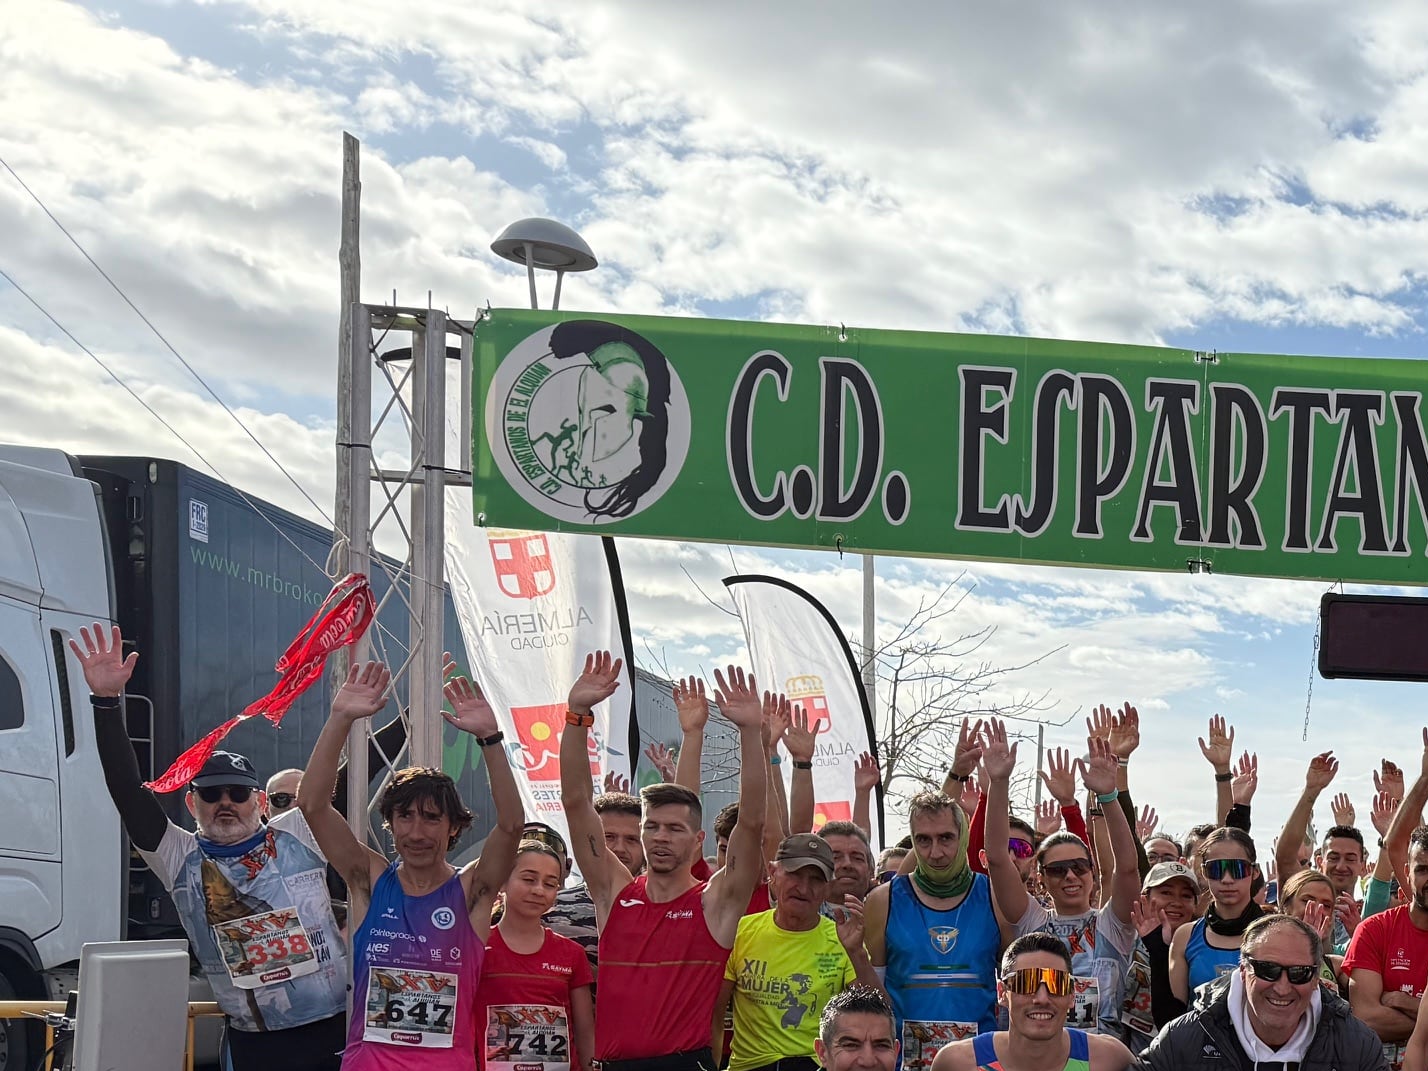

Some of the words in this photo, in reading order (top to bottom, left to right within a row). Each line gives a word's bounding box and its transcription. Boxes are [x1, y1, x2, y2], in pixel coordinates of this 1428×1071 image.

[514, 362, 552, 397] ALQUIAN
[509, 392, 528, 407] EL
[507, 405, 526, 422] DE
[726, 350, 910, 525] C.D.
[507, 426, 546, 480] ESPARTANOS
[190, 545, 324, 607] www.mrbroko
[246, 911, 292, 934] XV
[248, 934, 310, 965] 338
[742, 958, 768, 976] XII
[399, 972, 450, 993] XV
[740, 978, 790, 994] MUJER
[386, 1000, 453, 1027] 647
[517, 1008, 560, 1025] XV
[507, 1034, 567, 1056] 742
